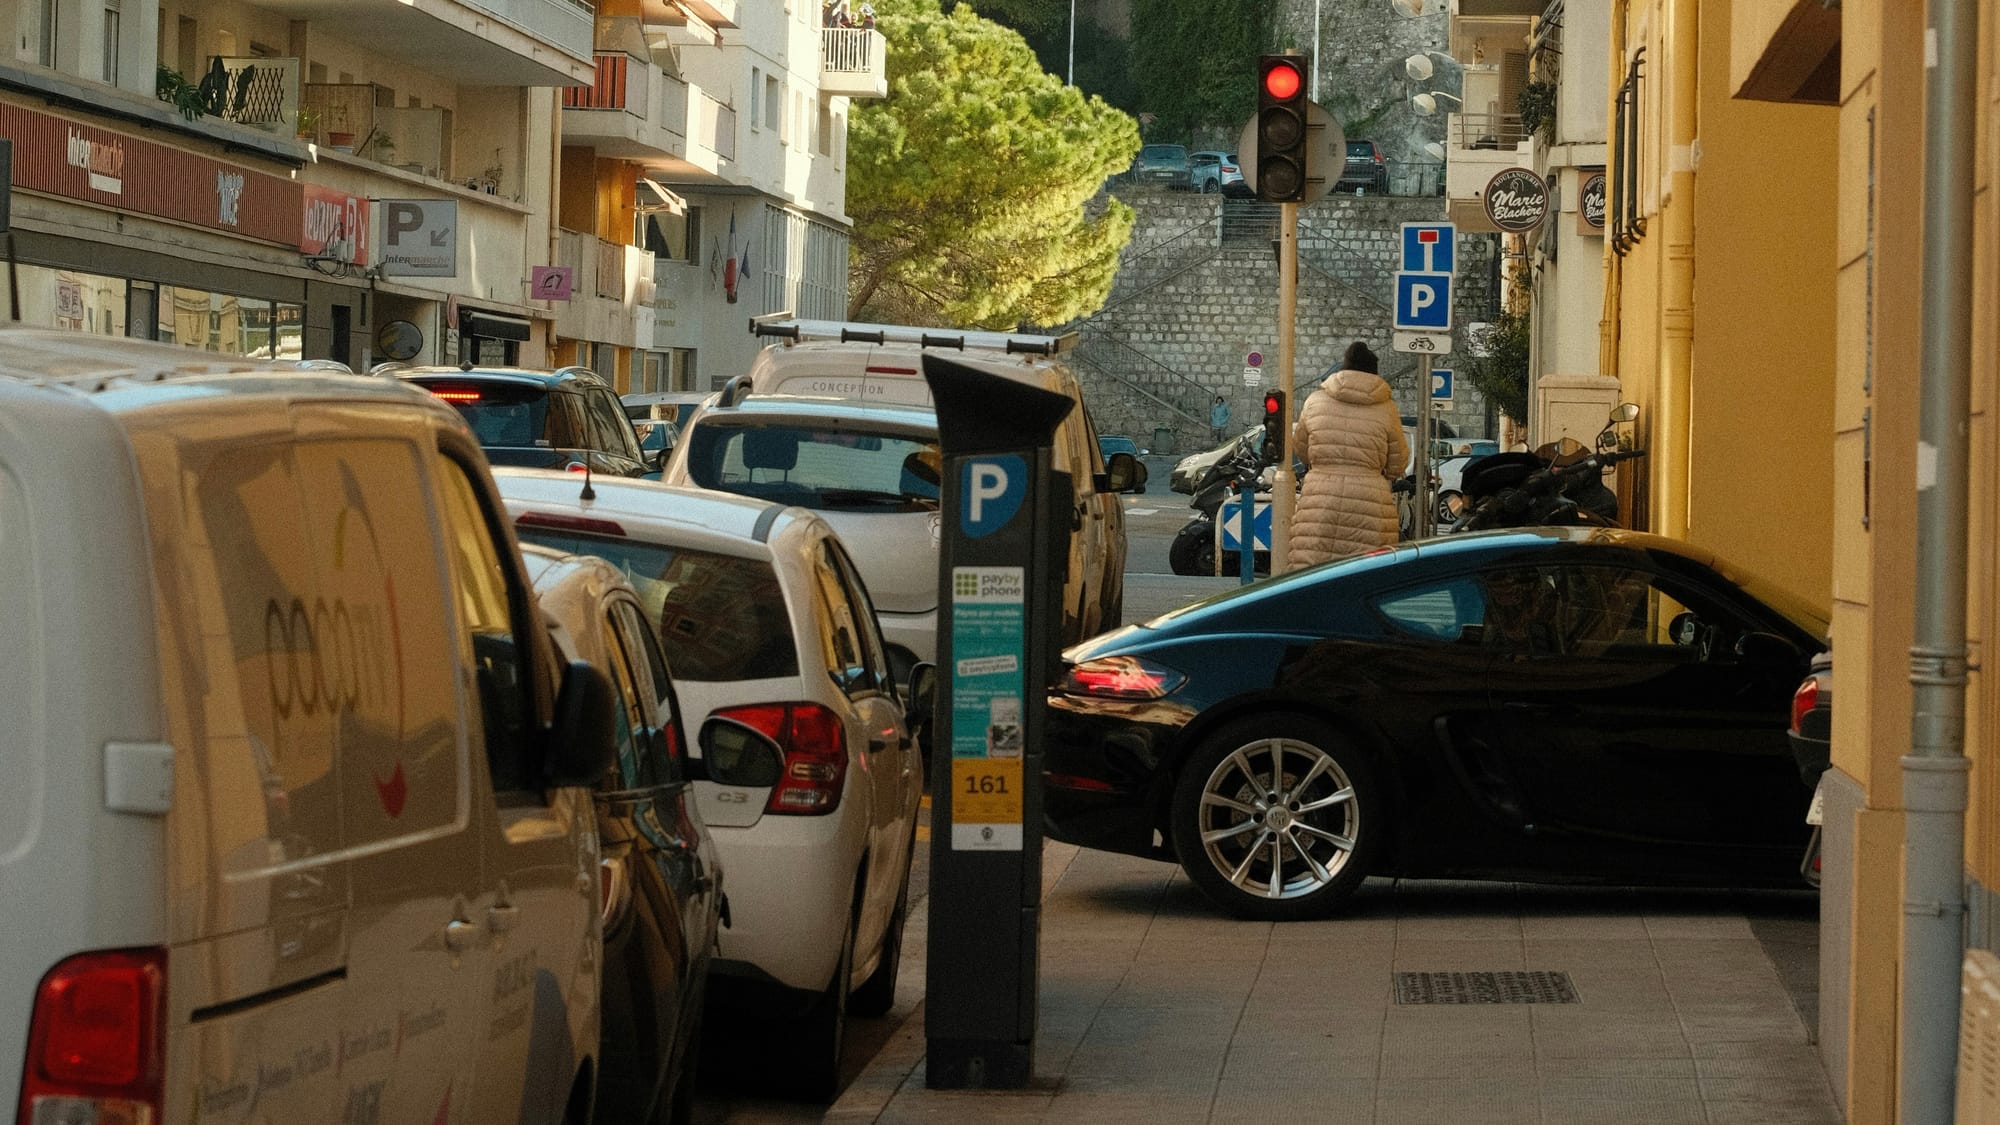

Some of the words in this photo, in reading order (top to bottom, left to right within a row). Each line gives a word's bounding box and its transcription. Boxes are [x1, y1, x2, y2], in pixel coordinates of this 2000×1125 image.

[1491, 190, 1544, 207] Marie
[387, 202, 424, 246] P
[1410, 284, 1435, 318] P
[812, 382, 884, 394] CONCEPTION
[1432, 375, 1445, 394] P
[969, 463, 1008, 522] P
[982, 585, 1021, 598] phone
[965, 775, 1009, 794] 161
[718, 792, 748, 804] C3
